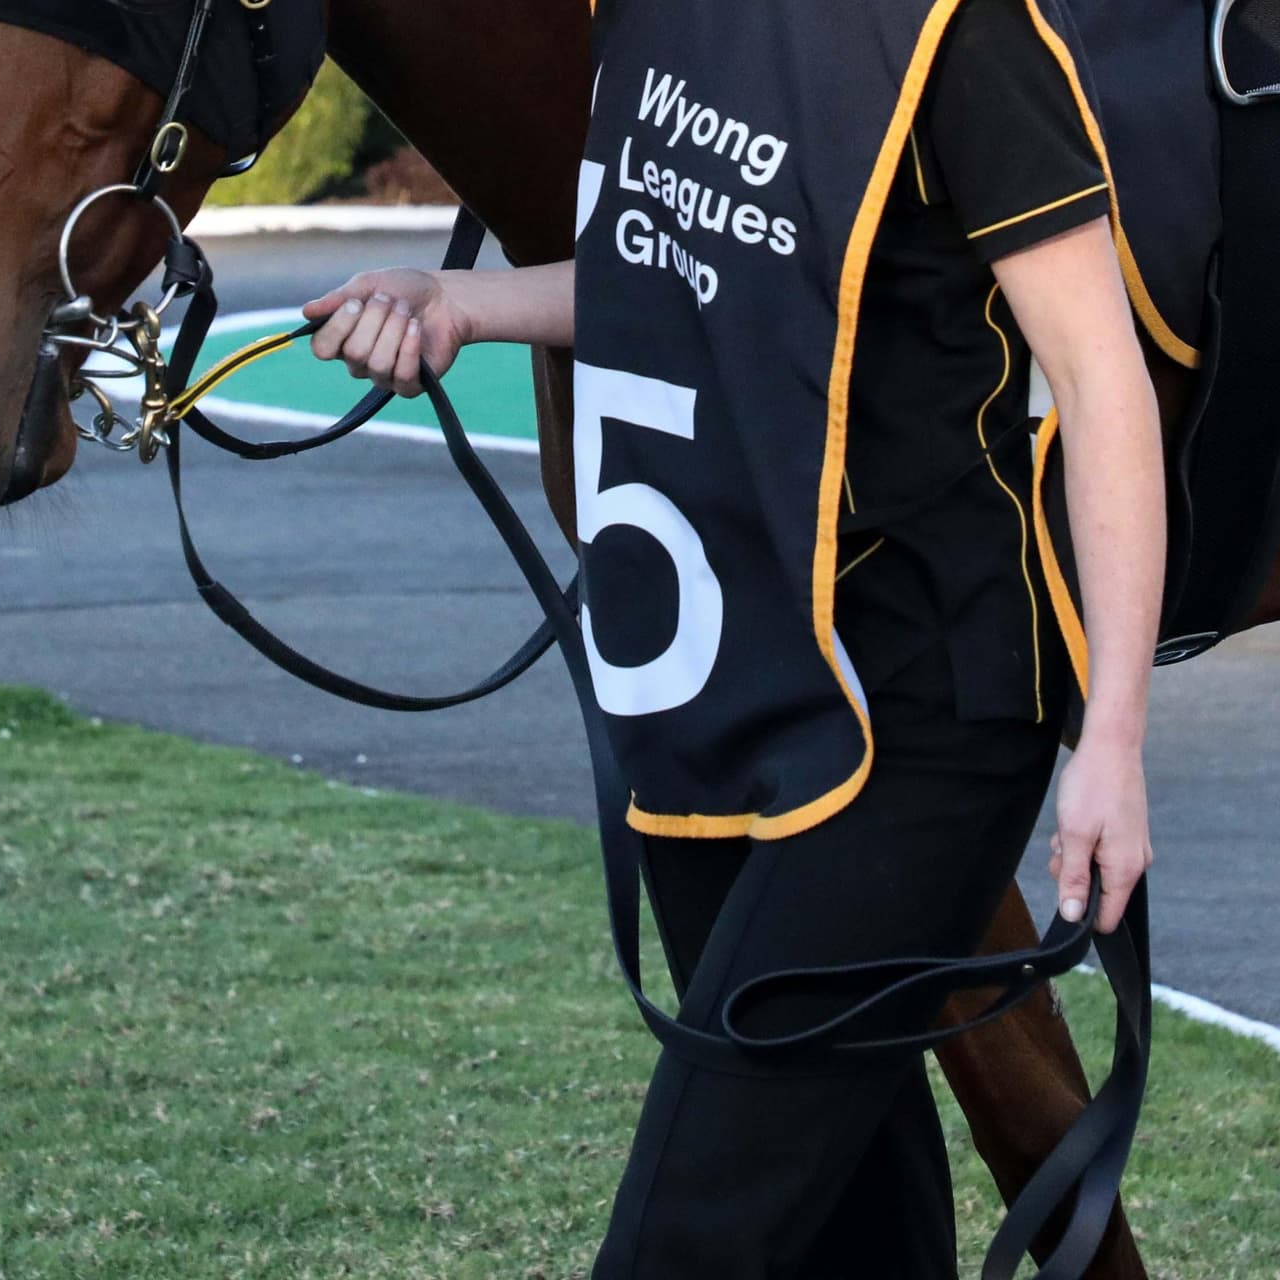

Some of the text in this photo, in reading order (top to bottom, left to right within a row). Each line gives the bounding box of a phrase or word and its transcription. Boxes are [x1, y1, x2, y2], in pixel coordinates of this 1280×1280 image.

[637, 67, 789, 187] Wyong
[618, 135, 797, 256] Leagues
[615, 208, 719, 312] Group
[572, 358, 724, 717] 5
